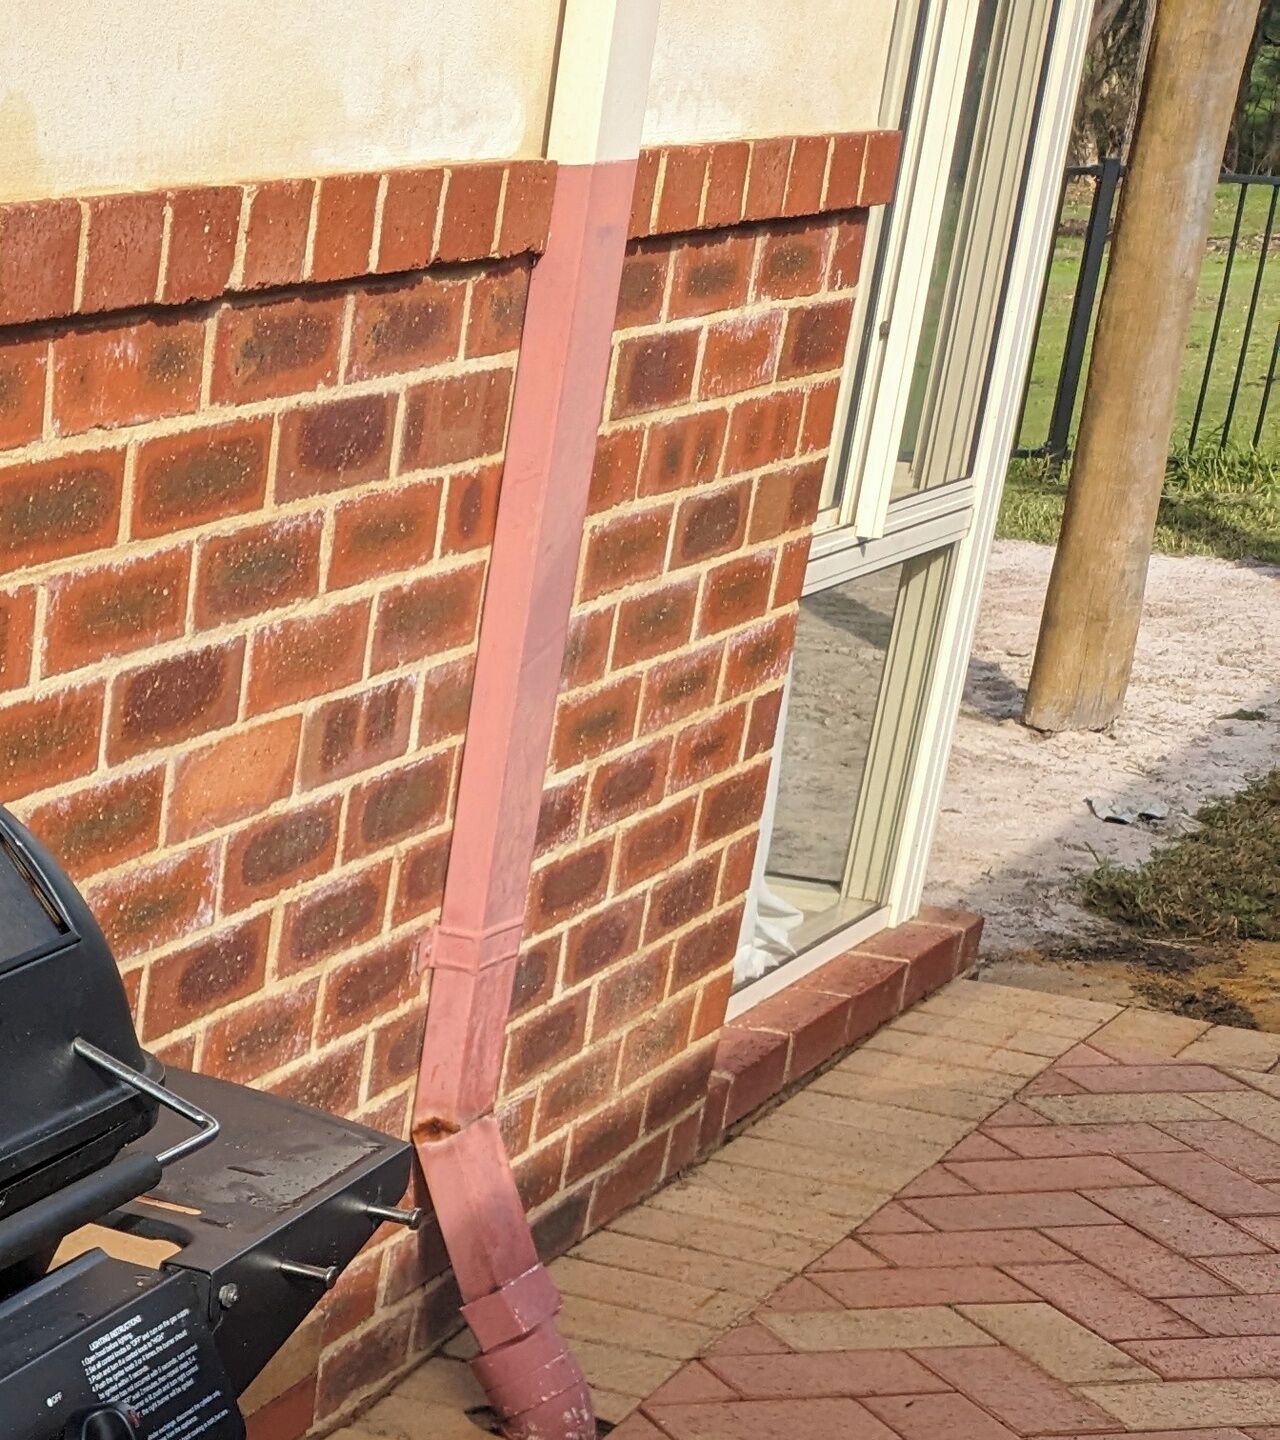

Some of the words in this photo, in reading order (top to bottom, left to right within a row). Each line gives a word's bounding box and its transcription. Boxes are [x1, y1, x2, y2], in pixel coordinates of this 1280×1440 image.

[88, 1333, 110, 1351] LIGHTING
[109, 1314, 142, 1338] INSTRUCTIONS
[52, 1392, 62, 1404] OFF
